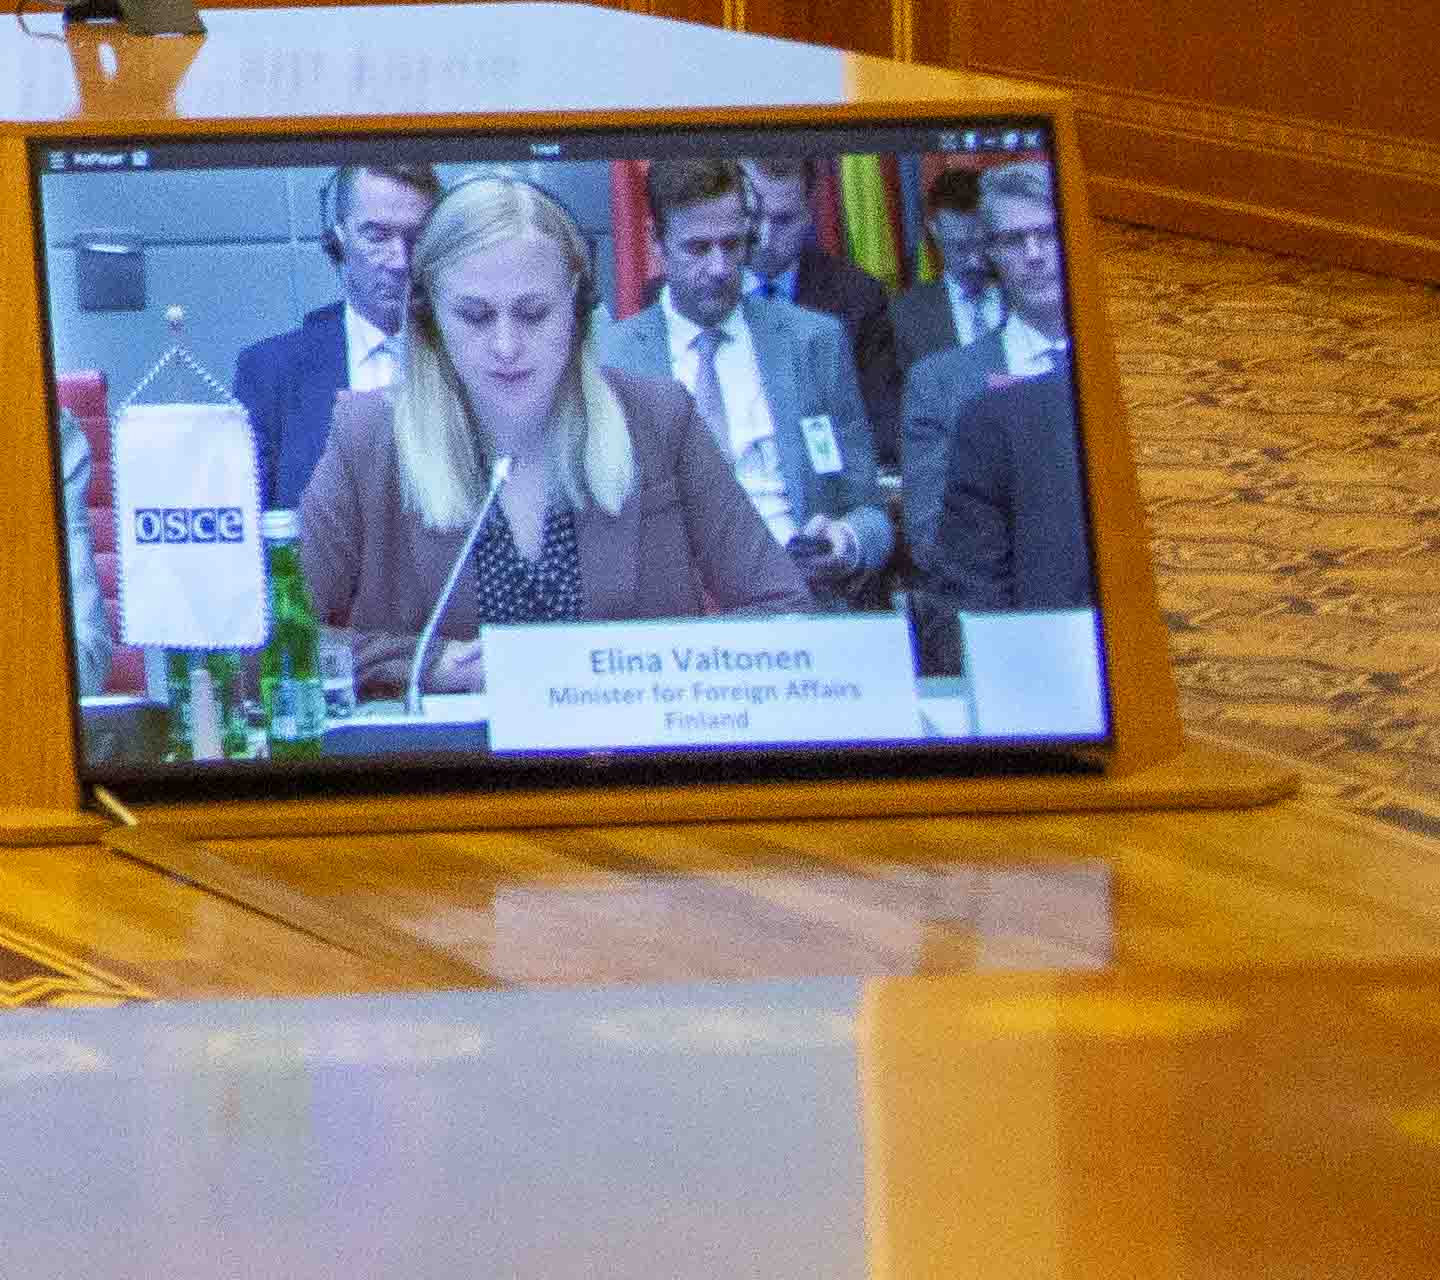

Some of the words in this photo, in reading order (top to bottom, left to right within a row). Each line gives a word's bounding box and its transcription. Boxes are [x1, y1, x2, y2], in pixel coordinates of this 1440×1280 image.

[590, 648, 663, 674] Elina
[671, 645, 813, 673] Valtonen
[548, 685, 645, 707] Minister
[652, 682, 686, 704] for
[693, 680, 778, 705] Foreign
[785, 678, 862, 702] Affairs
[663, 710, 750, 730] Finland
